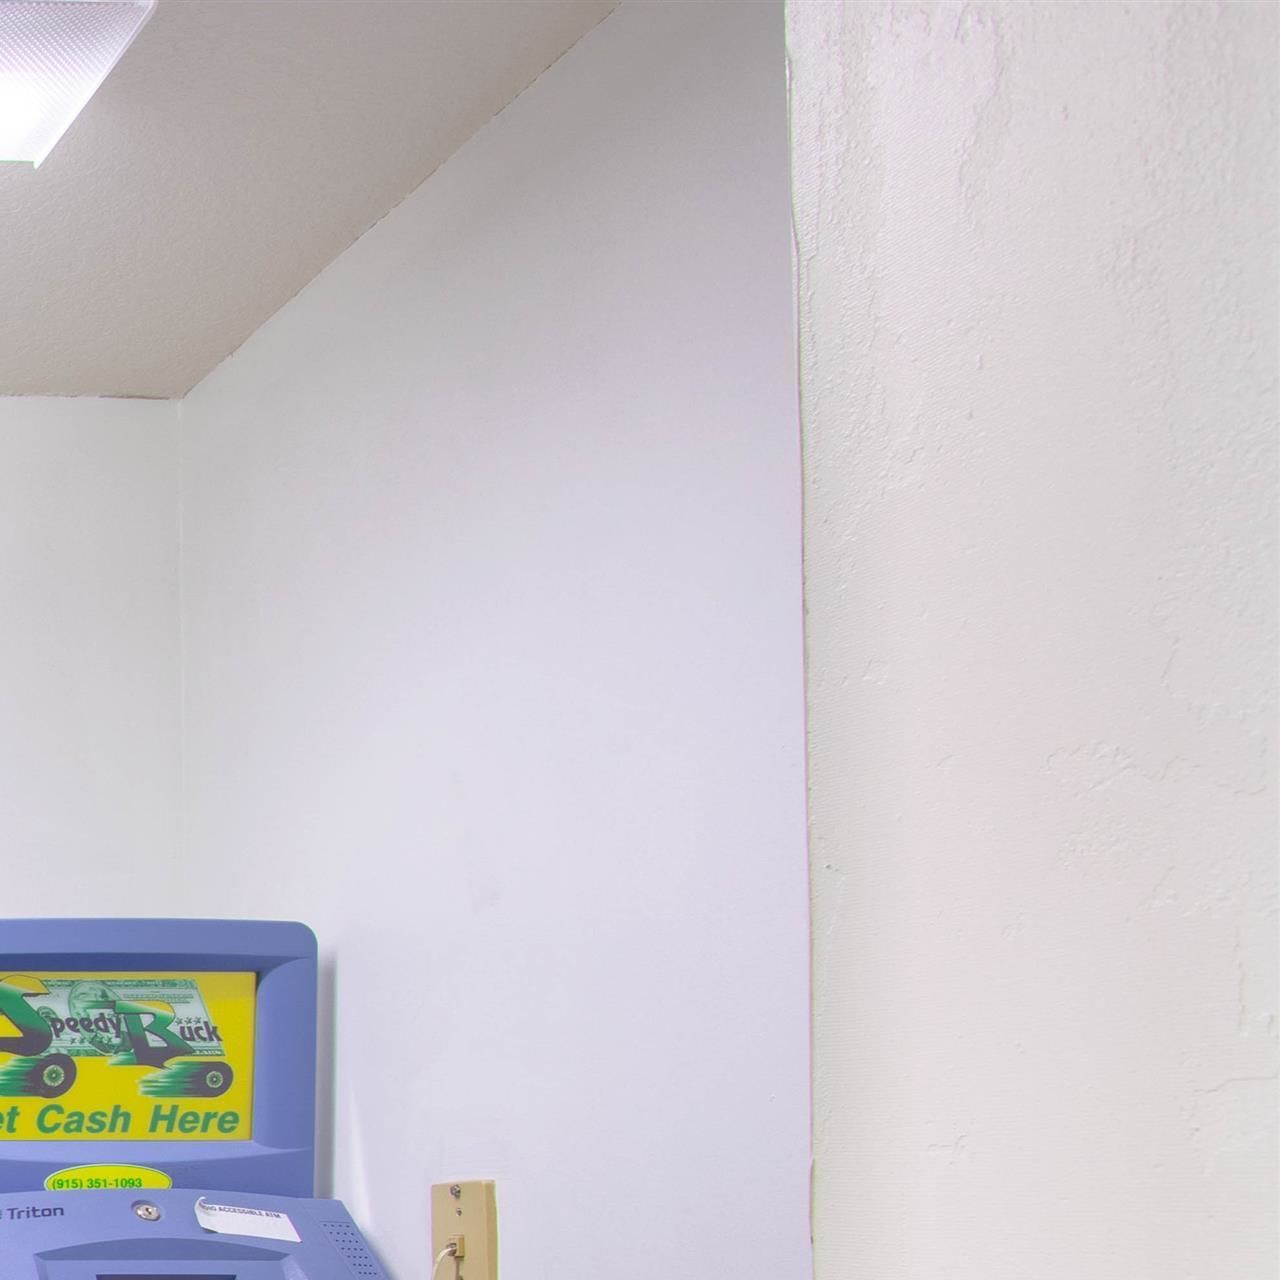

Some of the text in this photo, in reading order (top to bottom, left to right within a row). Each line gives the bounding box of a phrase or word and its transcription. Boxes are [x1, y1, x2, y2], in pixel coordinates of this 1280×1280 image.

[36, 1104, 131, 1134] Cash
[148, 1104, 240, 1134] Here
[52, 1177, 143, 1191] (915) 351-1093
[8, 1205, 64, 1220] Triton
